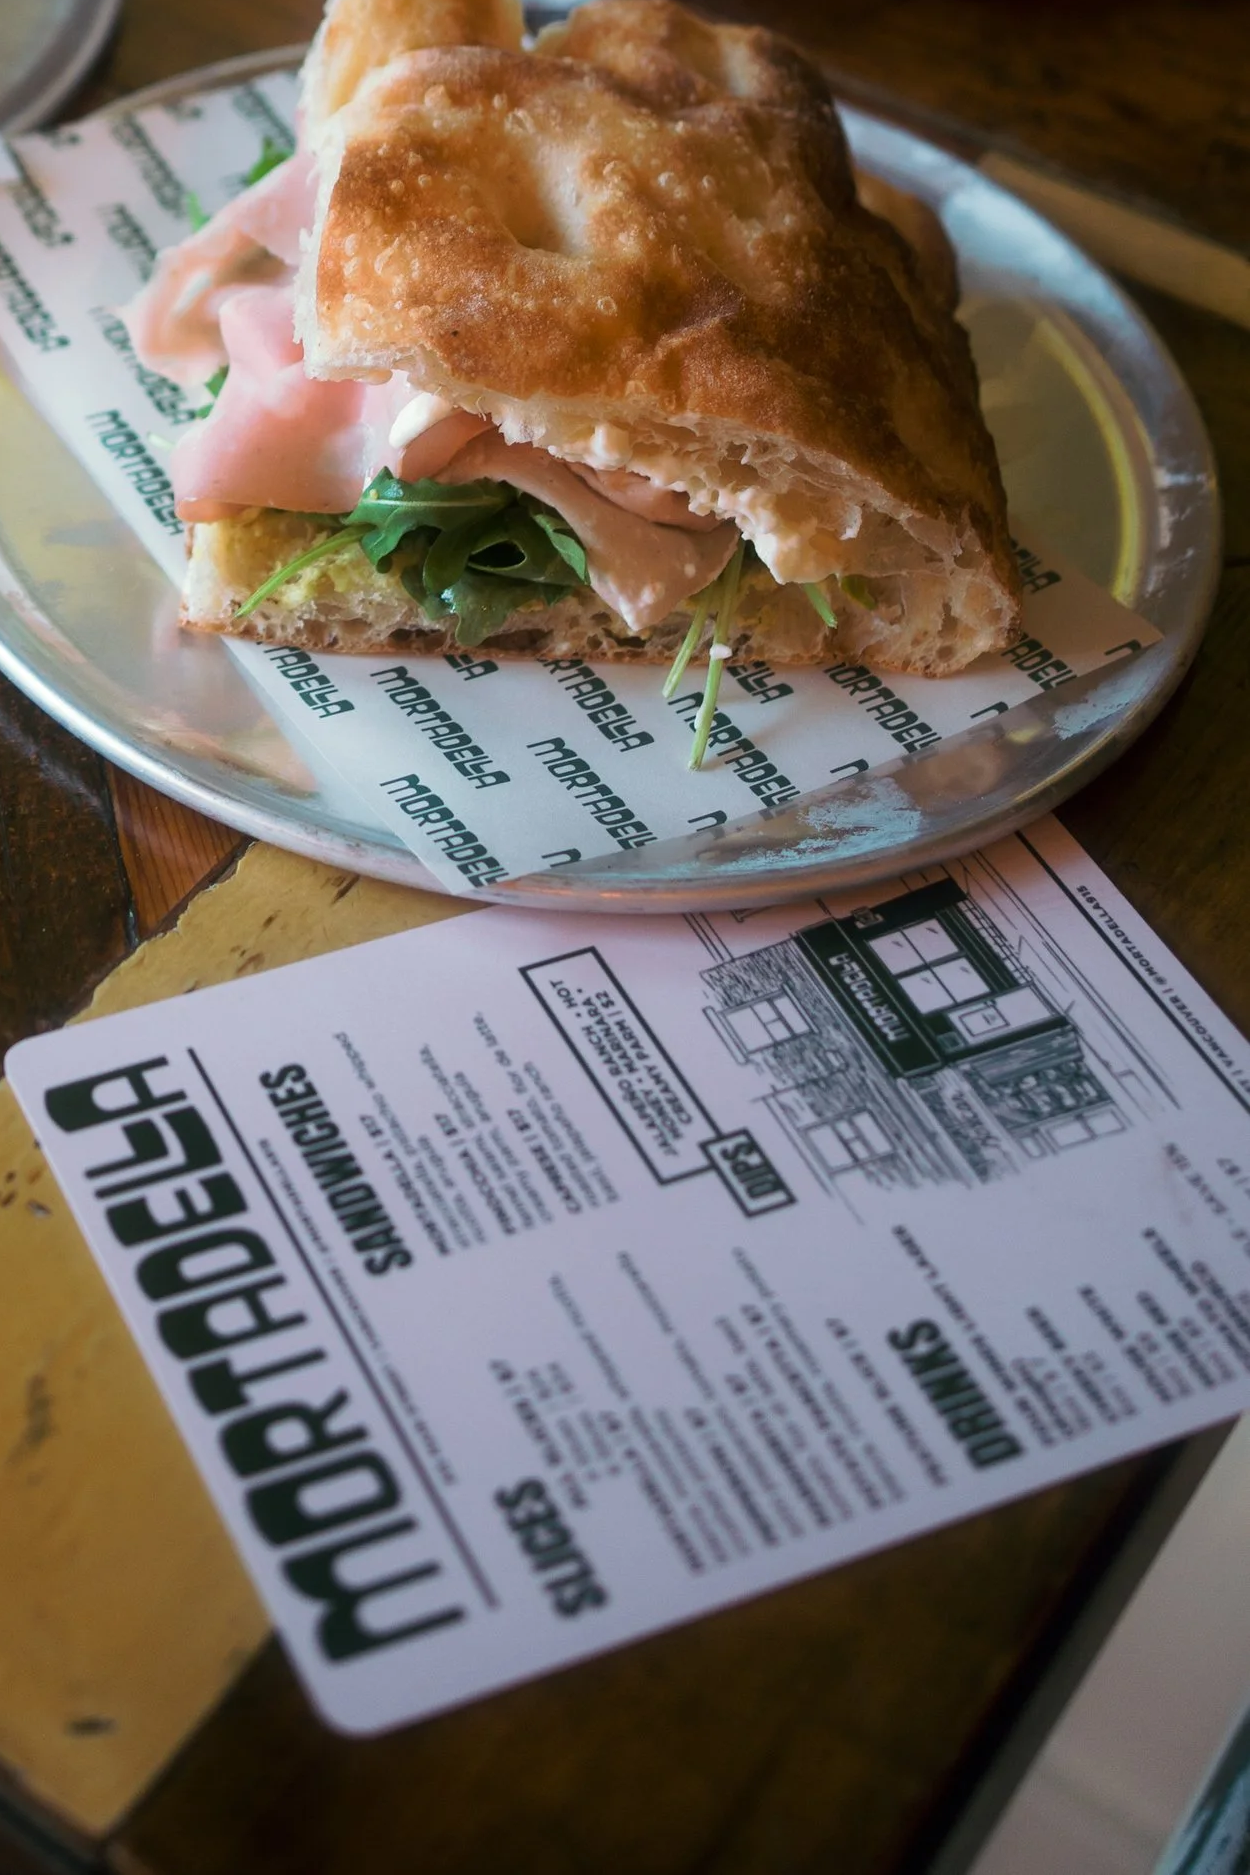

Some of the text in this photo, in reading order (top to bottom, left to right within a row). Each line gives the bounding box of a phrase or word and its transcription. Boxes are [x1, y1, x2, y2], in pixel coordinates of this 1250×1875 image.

[258, 641, 355, 719] TADELLA
[370, 665, 510, 790] MORTADELLA
[380, 773, 509, 888] MORTADELL
[527, 737, 659, 849] MORTADELL
[828, 953, 902, 1041] MORTADELLA
[1076, 884, 1235, 1069] VANCOUVER @MORTADELLA915
[333, 1032, 375, 1090] whipped
[549, 980, 678, 1155] JALAPEÑO RANCH HOT
[581, 996, 682, 1139] HONEY MARINARA
[595, 990, 692, 1124] CREAMY PARM $2
[259, 1064, 412, 1276] SANDWICHES
[359, 1115, 450, 1255] MORTADELLA $17
[372, 1093, 421, 1156] pistachio
[434, 1114, 515, 1235] FINOCCHIA $17
[507, 1109, 580, 1213] CAPRESE $17
[720, 1140, 780, 1199] DIPS
[44, 1056, 465, 1666] MORTADELLA
[887, 1320, 1023, 1469] DRINKS
[893, 1225, 1054, 1445] FOUR WINDS LIGHT LAGER
[1080, 1287, 1172, 1402] HOUSE WHITE
[1139, 1293, 1214, 1387] HOUSE RED
[495, 1479, 607, 1617] SLICES
